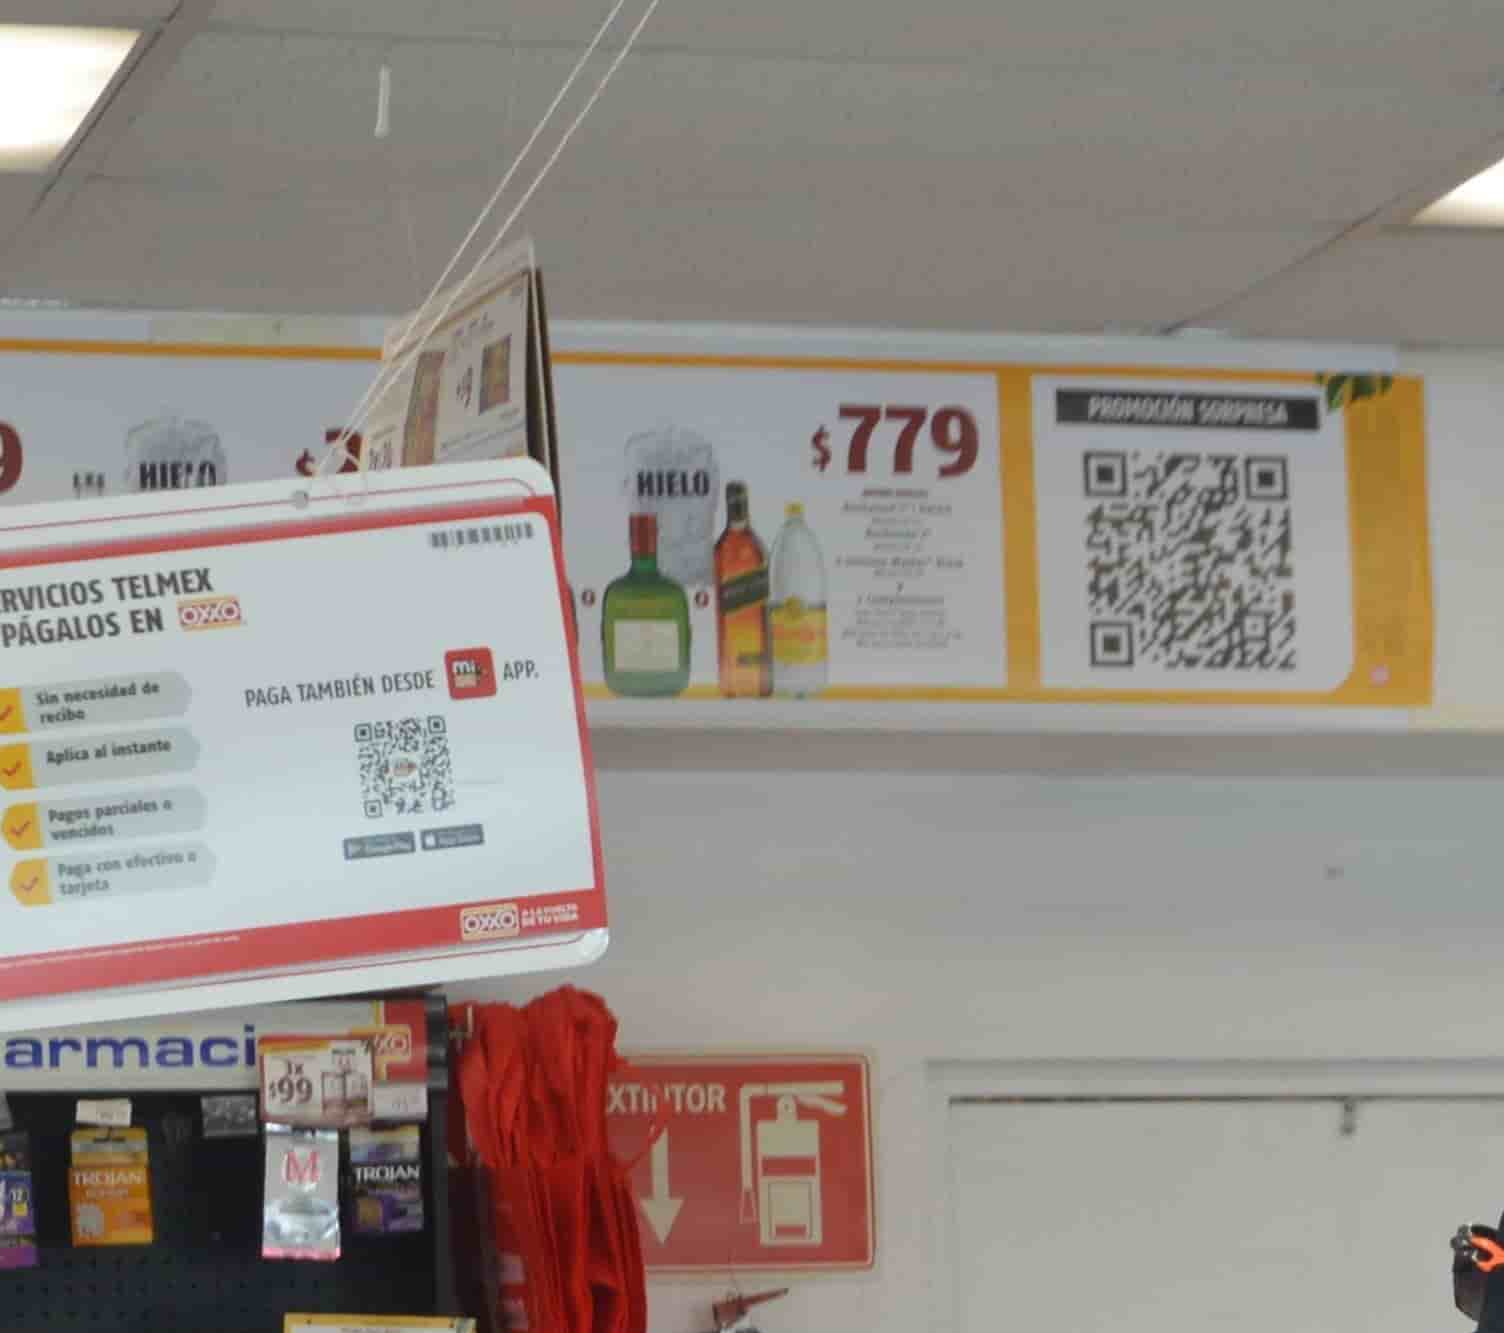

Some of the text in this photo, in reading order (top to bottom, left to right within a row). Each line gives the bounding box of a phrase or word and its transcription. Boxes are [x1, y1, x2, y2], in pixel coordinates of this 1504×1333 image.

[1086, 392, 1290, 427] PROMOCIÓN SORPRESA
[811, 404, 980, 479] $779
[637, 469, 709, 500] HIELO
[111, 567, 214, 602] TELMEX
[1, 611, 121, 650] PÁGALOS
[130, 607, 164, 635] EN
[178, 599, 242, 628] OXXO
[64, 681, 137, 704] necesidad
[141, 681, 160, 695] de
[244, 660, 540, 709] PAGA TAMBIÉN DESDE APP.
[462, 907, 519, 937] OXXO
[73, 1170, 144, 1186] TROJAN
[353, 1163, 421, 1183] TROJAN
